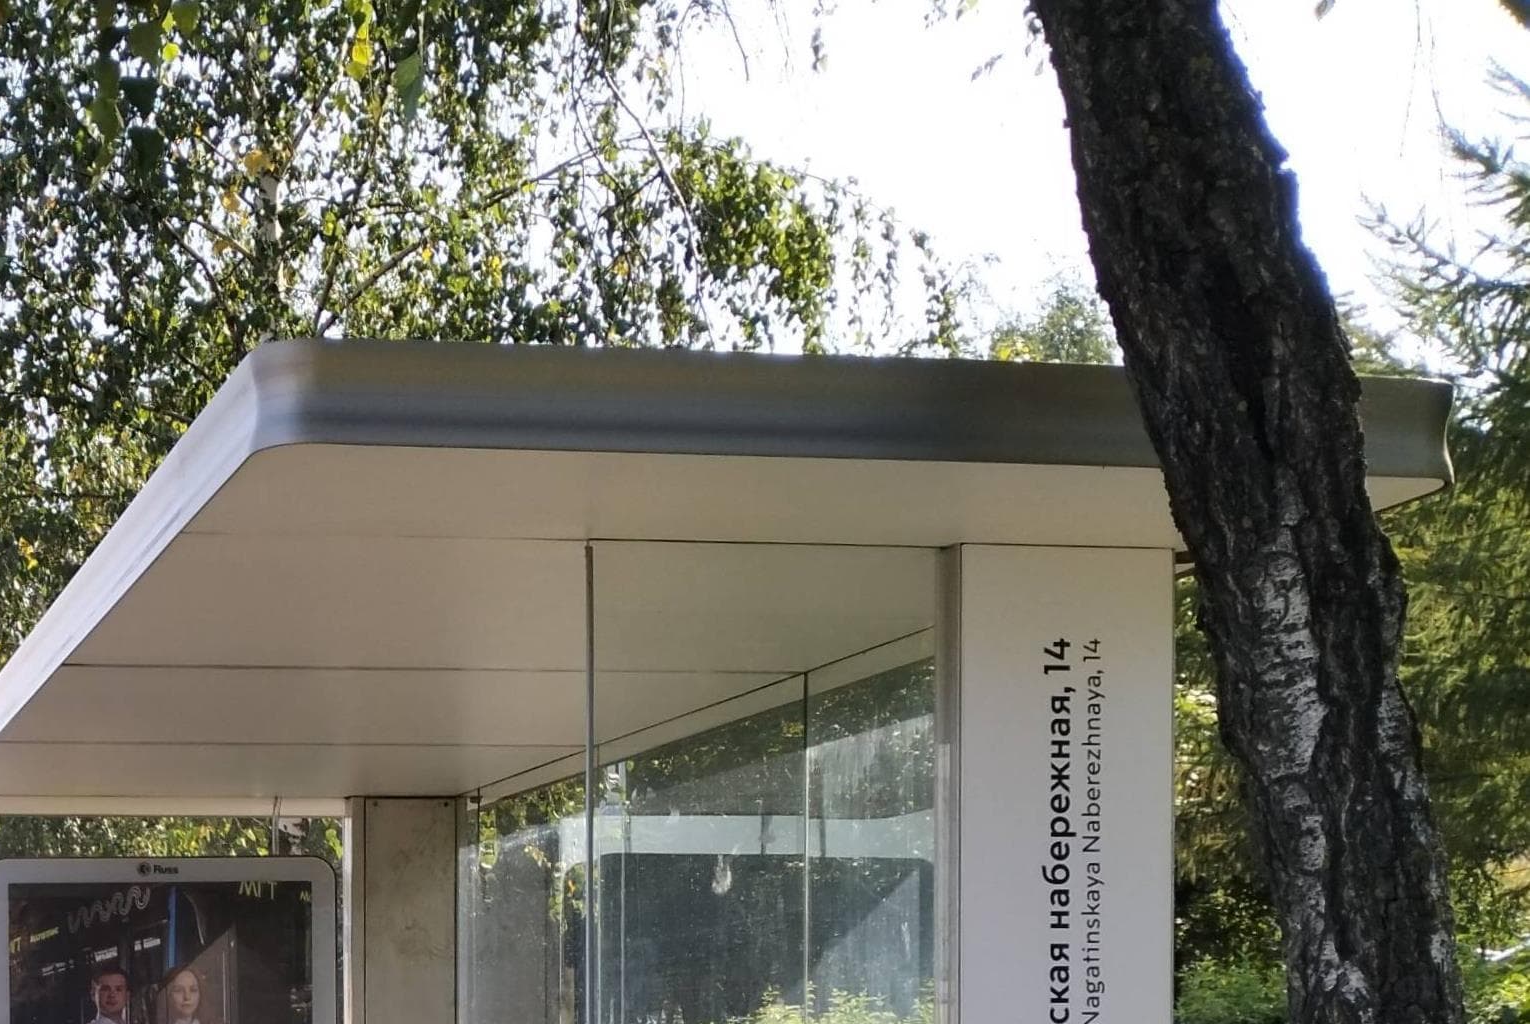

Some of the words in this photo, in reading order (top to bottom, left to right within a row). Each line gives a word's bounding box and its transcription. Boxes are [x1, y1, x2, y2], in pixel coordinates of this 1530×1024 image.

[1043, 637, 1071, 676] 14
[1082, 638, 1102, 663] 14
[1081, 669, 1106, 853] Naberezhnaya,
[1041, 686, 1076, 929] набережная,
[153, 864, 179, 875] Russ
